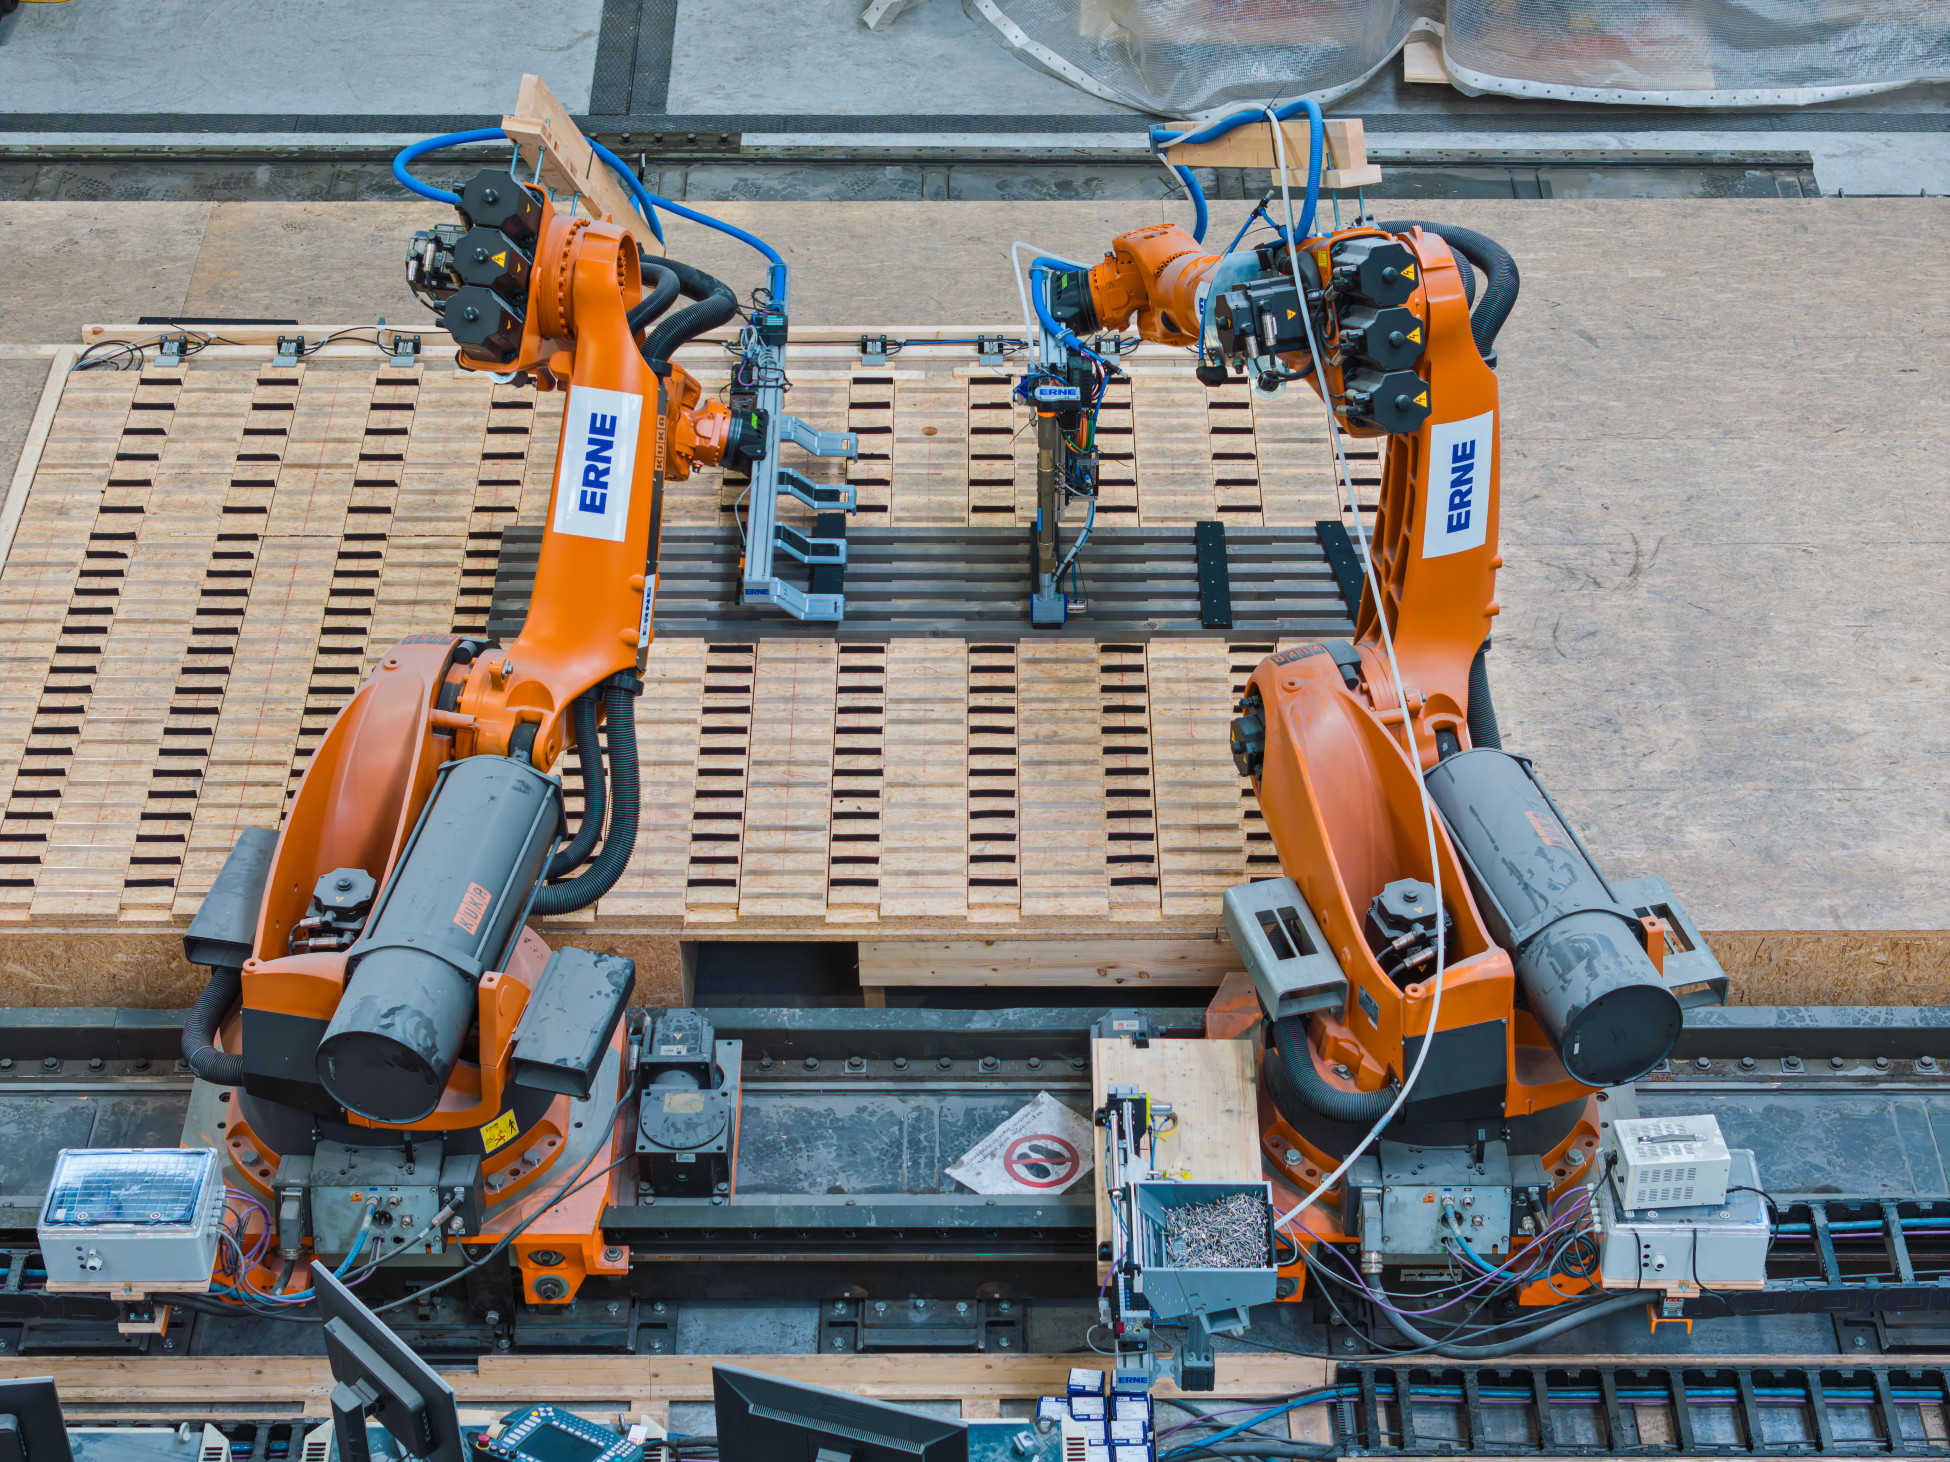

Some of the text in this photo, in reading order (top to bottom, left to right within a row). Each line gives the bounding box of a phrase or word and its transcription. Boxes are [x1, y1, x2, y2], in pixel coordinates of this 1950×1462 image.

[1039, 388, 1077, 396] ERNE
[579, 412, 618, 515] ERNE
[655, 416, 666, 470] KUKA
[1446, 439, 1476, 534] ERNE
[744, 588, 770, 596] ERNE
[459, 886, 489, 932] KUKA
[1118, 1376, 1149, 1385] ERNE
